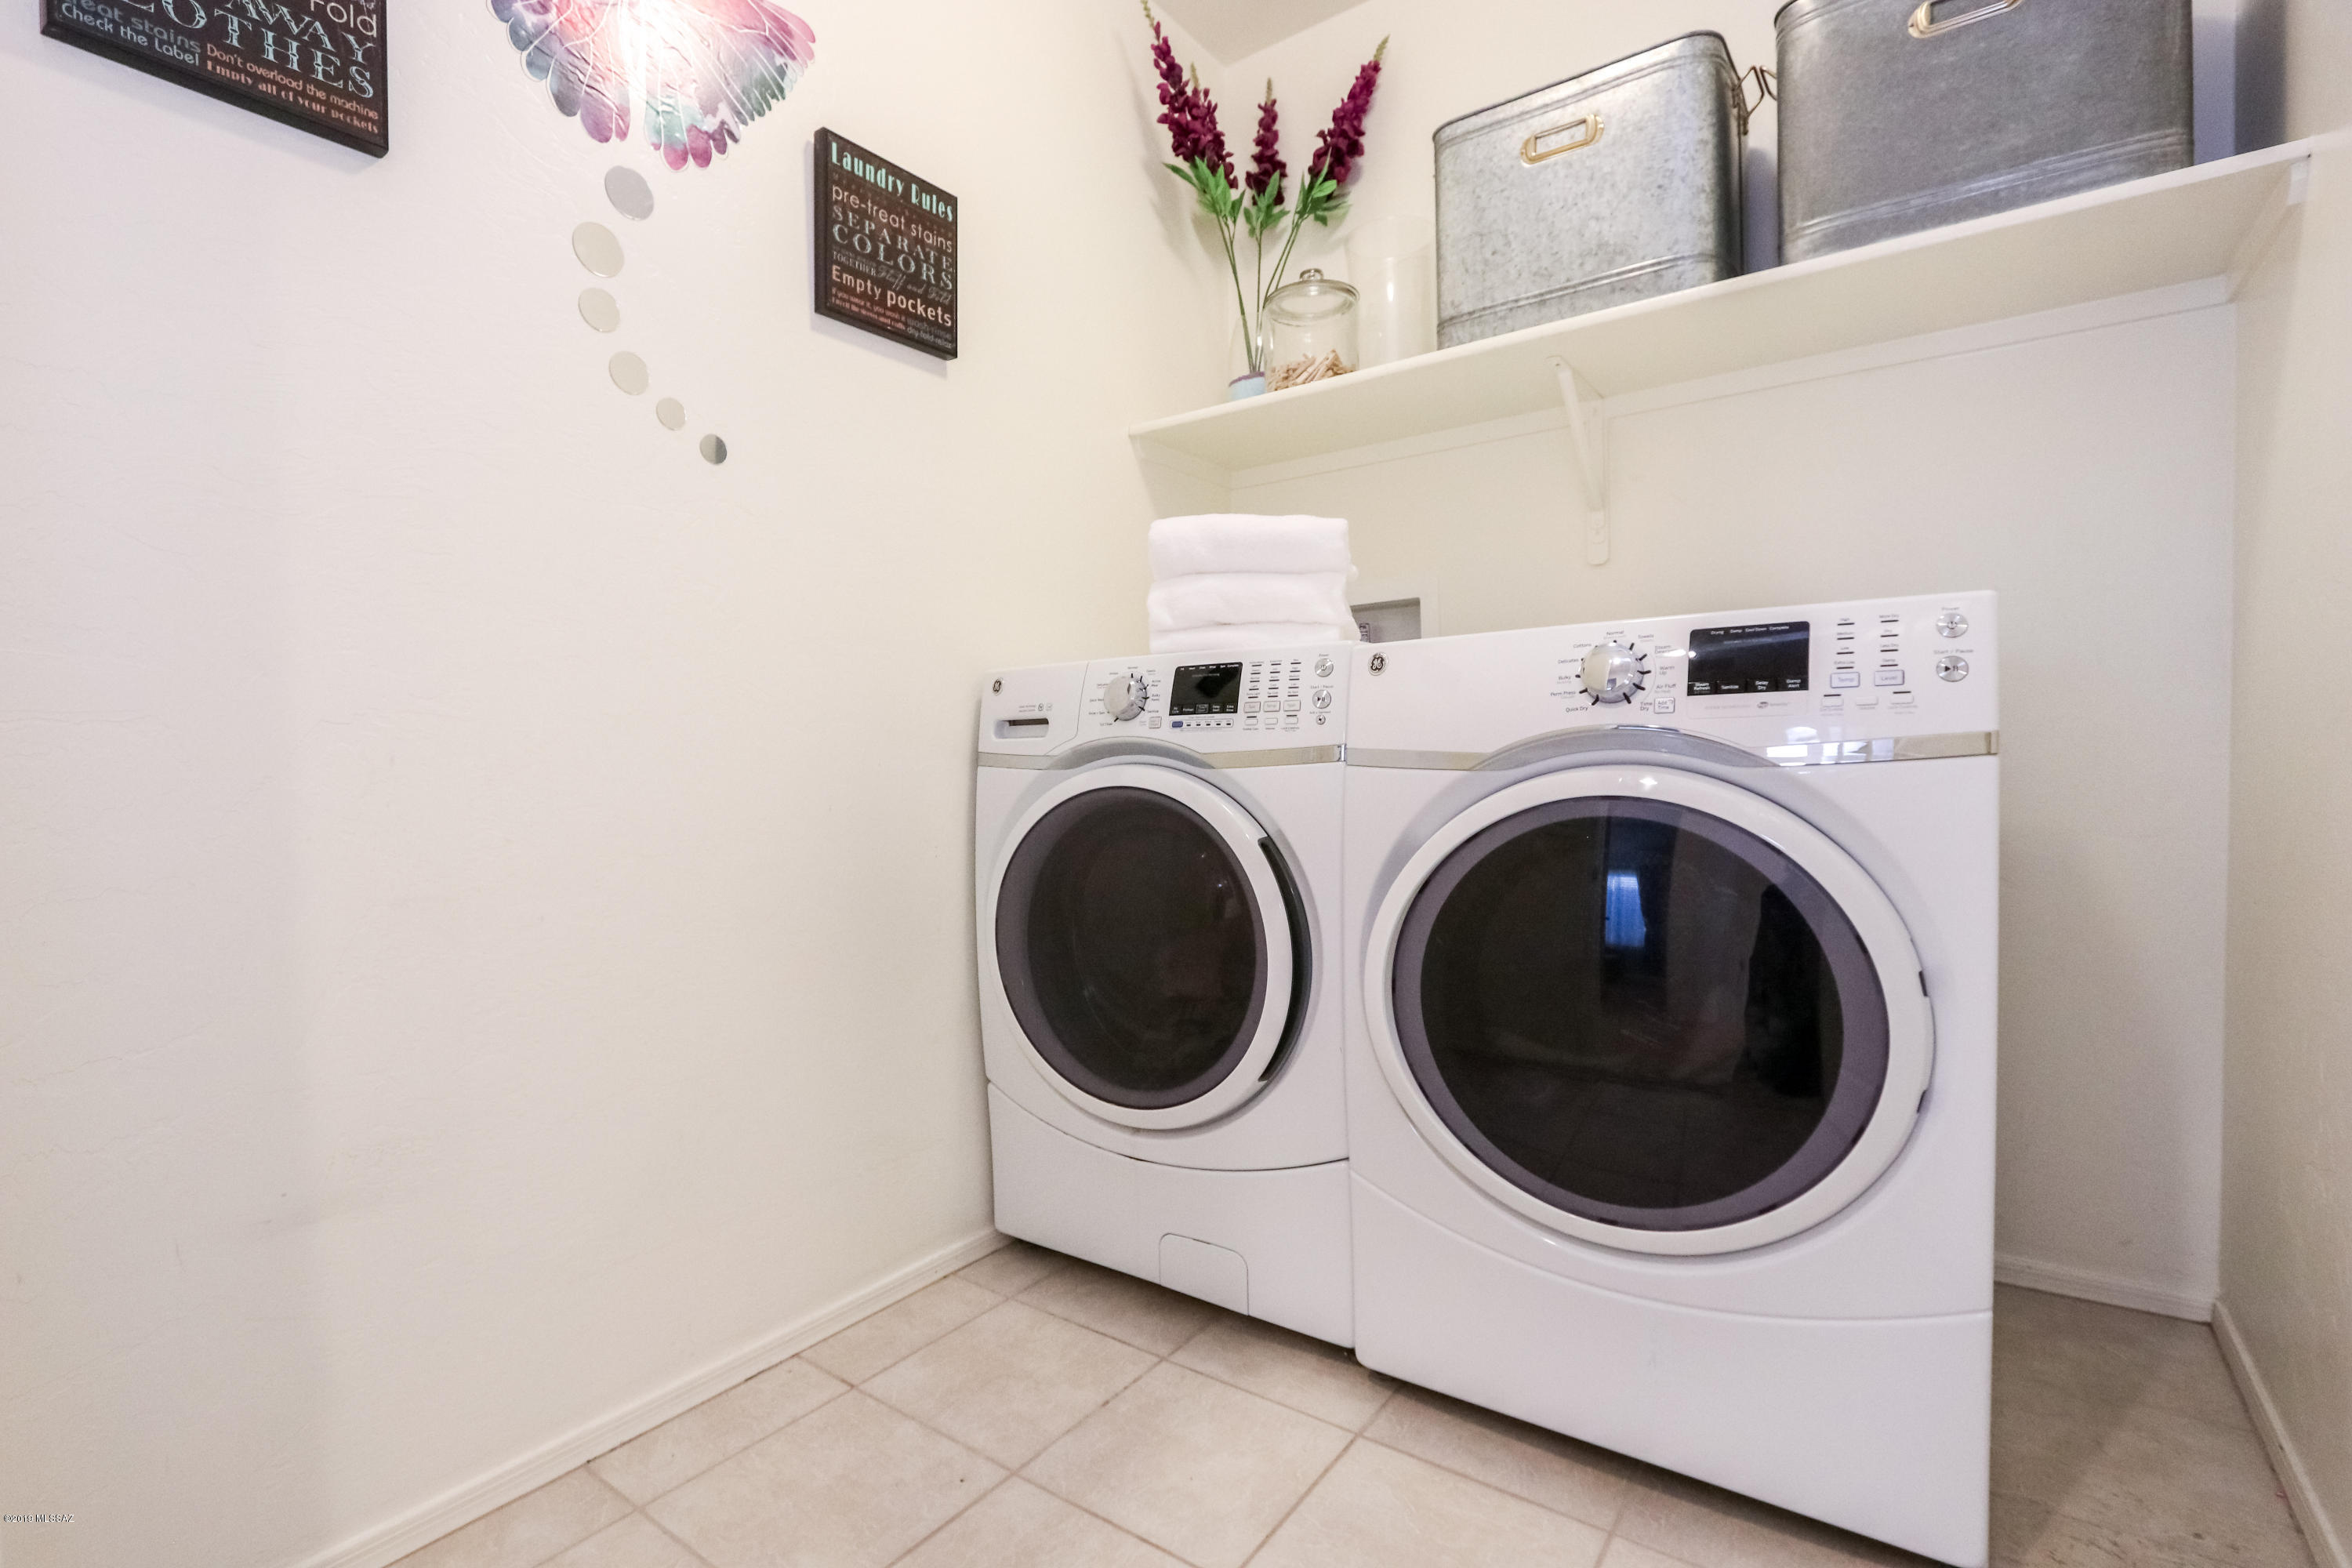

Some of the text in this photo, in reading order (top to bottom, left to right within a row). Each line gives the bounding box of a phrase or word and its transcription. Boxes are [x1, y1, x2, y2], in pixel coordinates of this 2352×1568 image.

[62, 3, 114, 33] Check
[120, 25, 148, 46] the
[122, 0, 374, 98] OTHES
[132, 17, 201, 53] stains
[207, 43, 378, 119] Don't overload the machine
[259, 82, 277, 96] all
[297, 96, 326, 114] your
[832, 142, 953, 222] Laundry Rules
[833, 185, 952, 252] pre-treat stains
[833, 205, 952, 271] SEPARATE
[833, 224, 952, 289] COLORS
[833, 251, 877, 276] TOGETHER
[832, 264, 951, 326] Empty pockets
